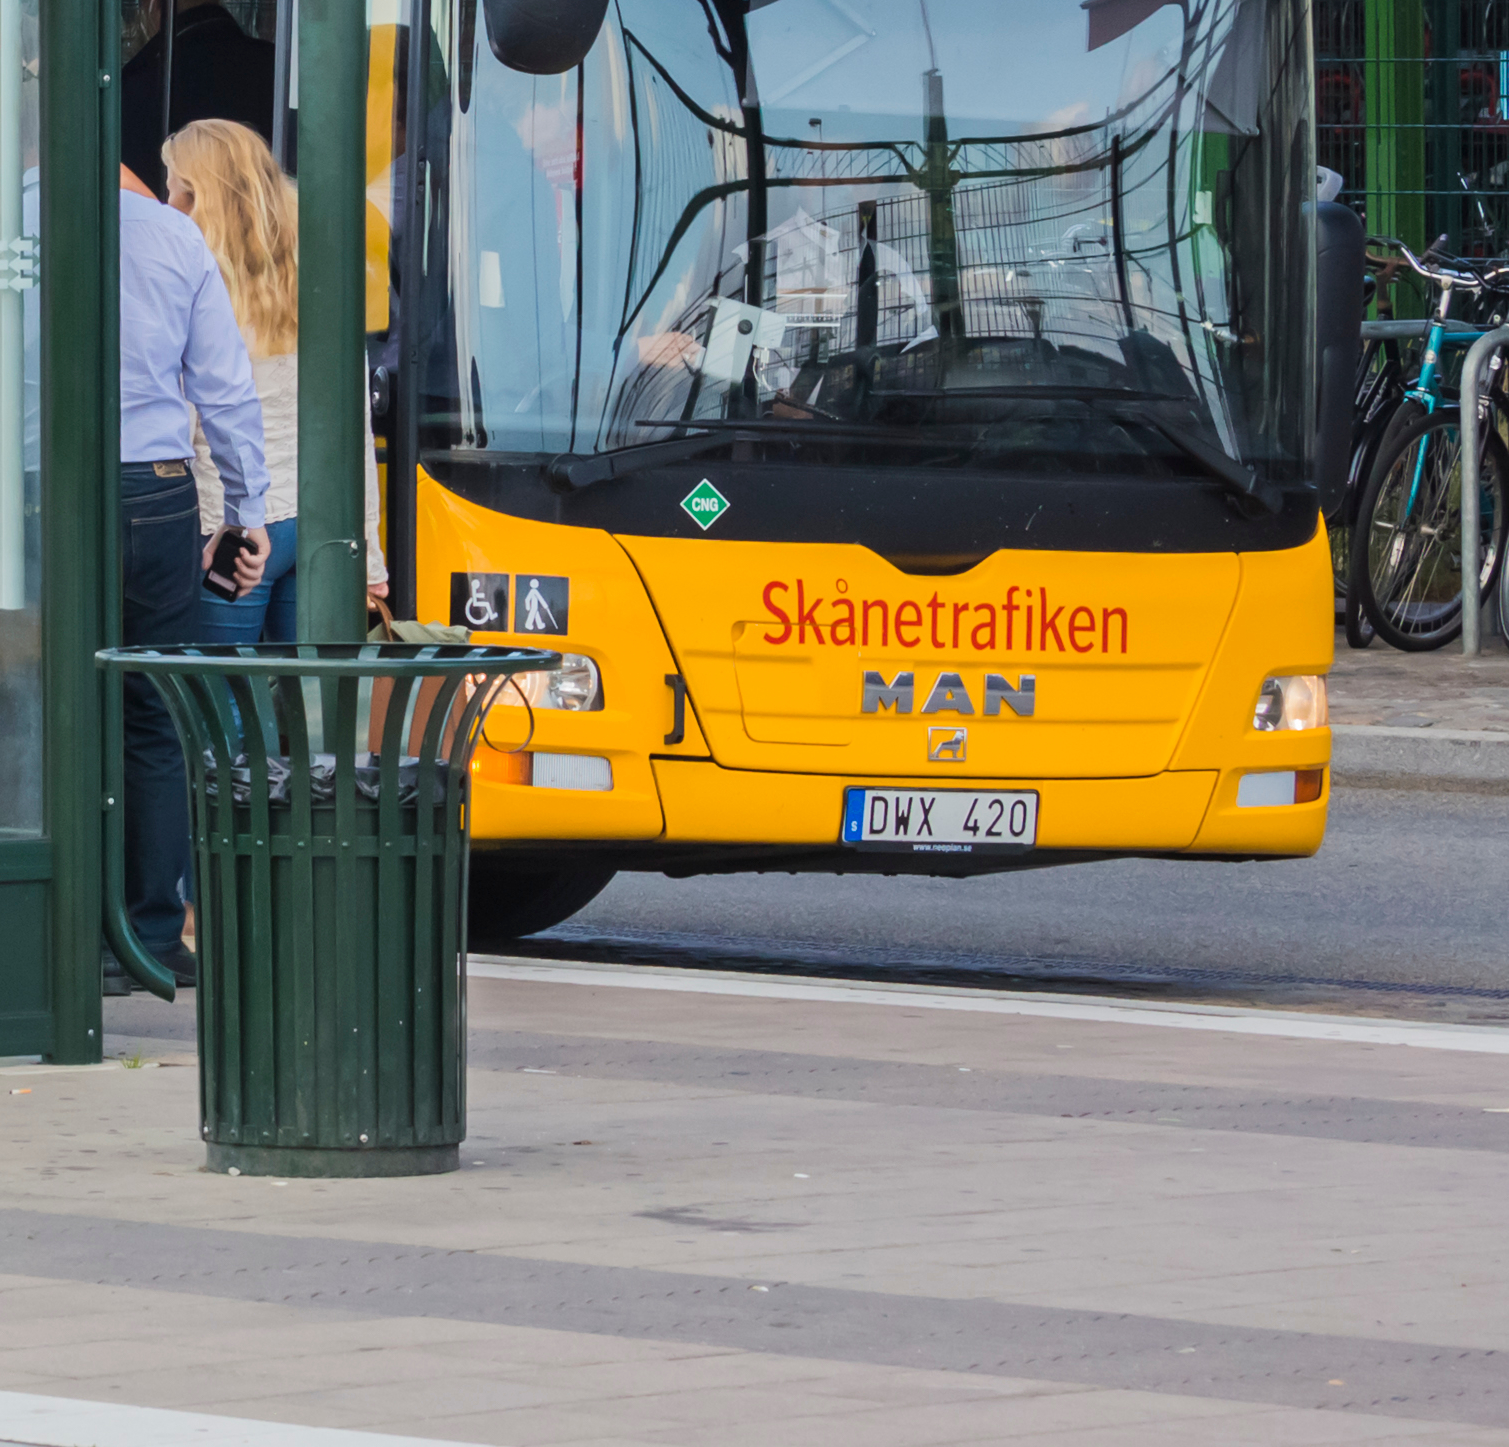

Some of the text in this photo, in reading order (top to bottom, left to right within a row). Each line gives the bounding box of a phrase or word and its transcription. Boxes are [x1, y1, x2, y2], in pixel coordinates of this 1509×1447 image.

[691, 497, 719, 512] CNG
[762, 578, 1129, 654] Skånetrafiken
[861, 670, 1036, 716] MAN
[850, 820, 858, 832] S
[869, 796, 1028, 837] DWX 420
[912, 843, 973, 853] www.neoplan.se
